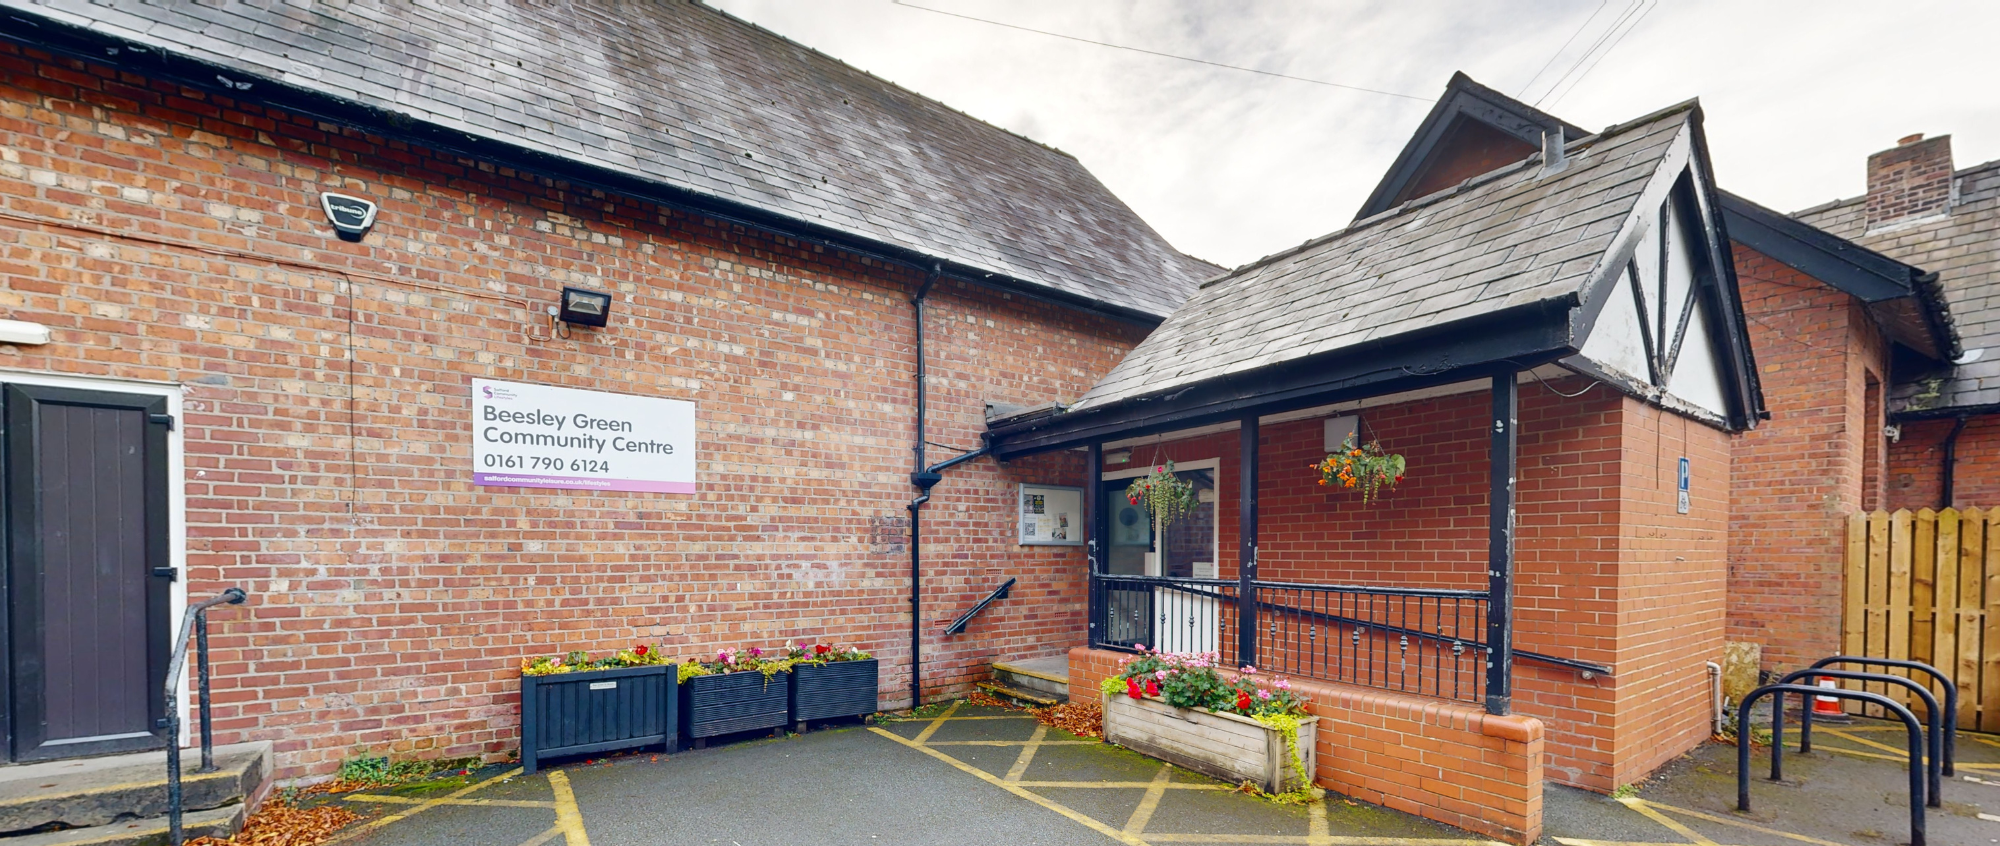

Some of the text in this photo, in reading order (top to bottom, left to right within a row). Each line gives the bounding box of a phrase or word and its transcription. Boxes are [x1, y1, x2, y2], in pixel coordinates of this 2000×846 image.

[330, 204, 362, 215] tribune
[483, 405, 632, 432] Beesley Green
[483, 427, 674, 455] Community Centre
[484, 454, 610, 473] 0161 790 6124
[1681, 460, 1688, 488] P
[483, 475, 611, 487] salfordcommunityleisure.co.uk/lifestyles
